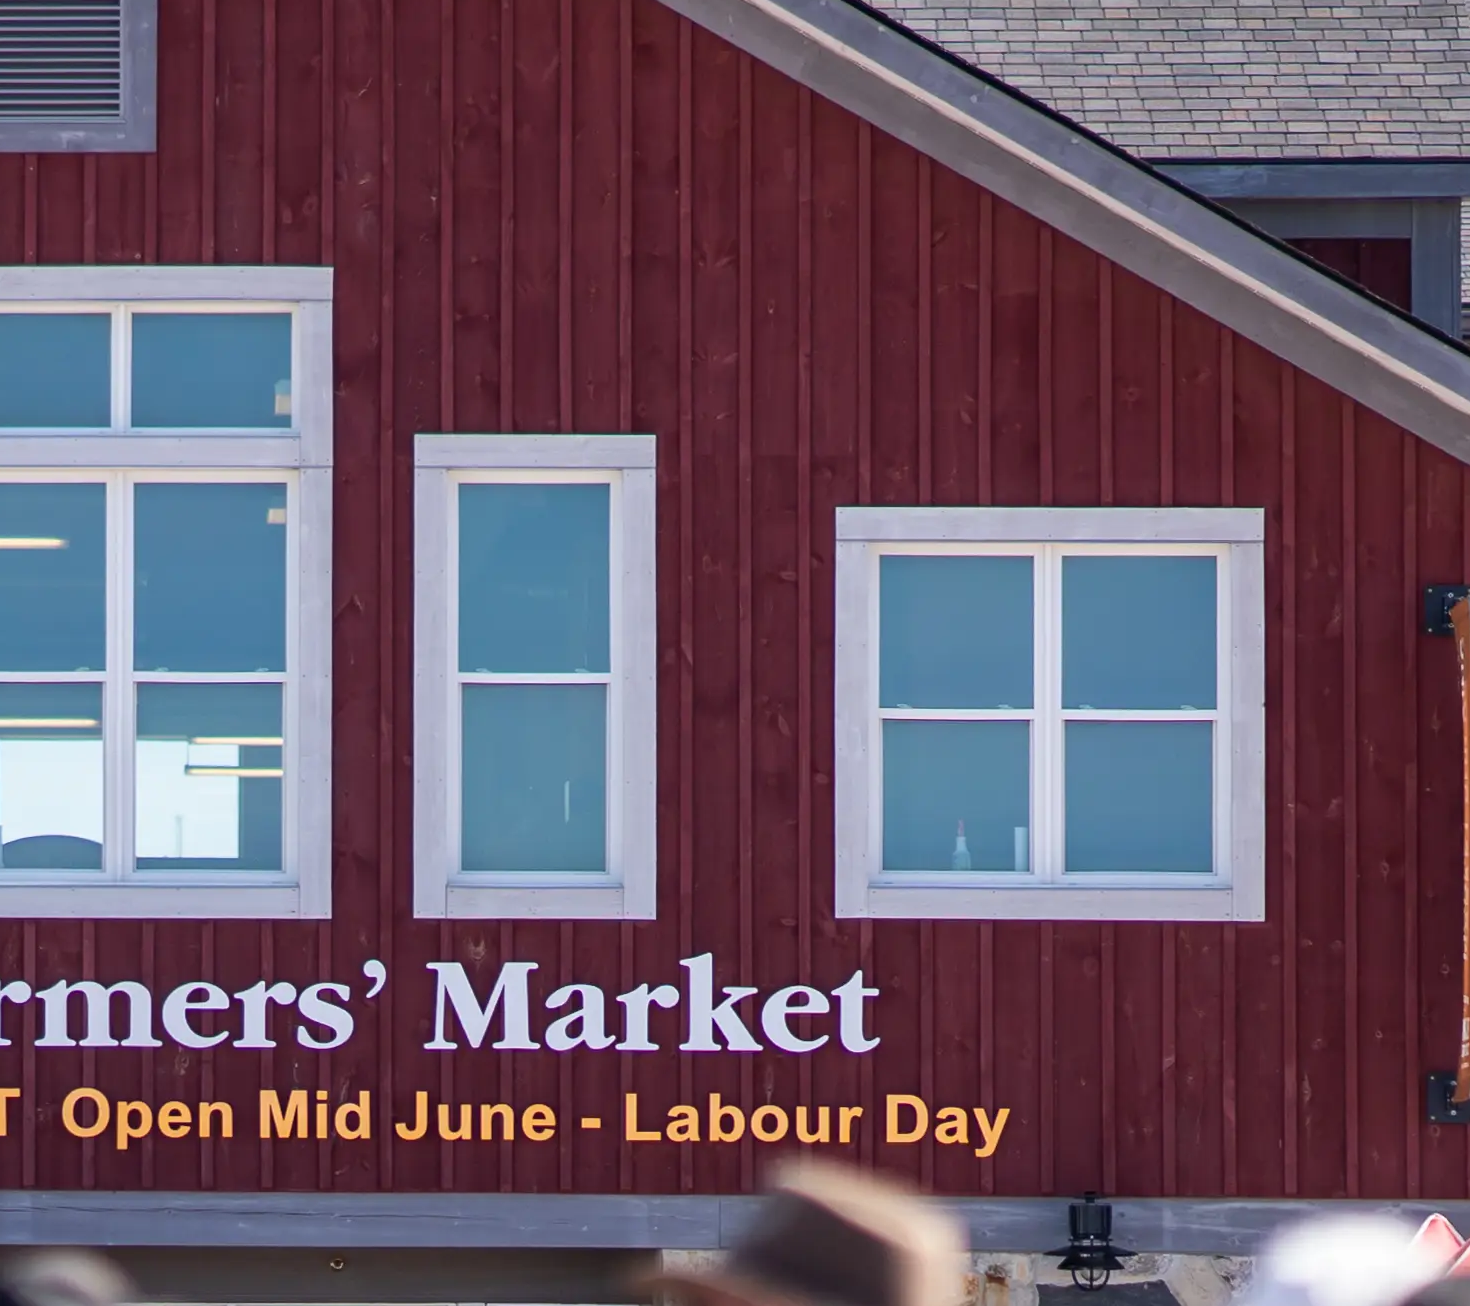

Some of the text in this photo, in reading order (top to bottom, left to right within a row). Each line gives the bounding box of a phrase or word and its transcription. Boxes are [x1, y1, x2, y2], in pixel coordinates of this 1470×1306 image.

[423, 952, 881, 1053] Market
[61, 1087, 233, 1150] Open
[259, 1089, 371, 1140] Mid
[395, 1090, 557, 1142] June
[581, 1117, 602, 1129] -
[625, 1092, 864, 1144] Labour
[886, 1094, 1011, 1158] Day
